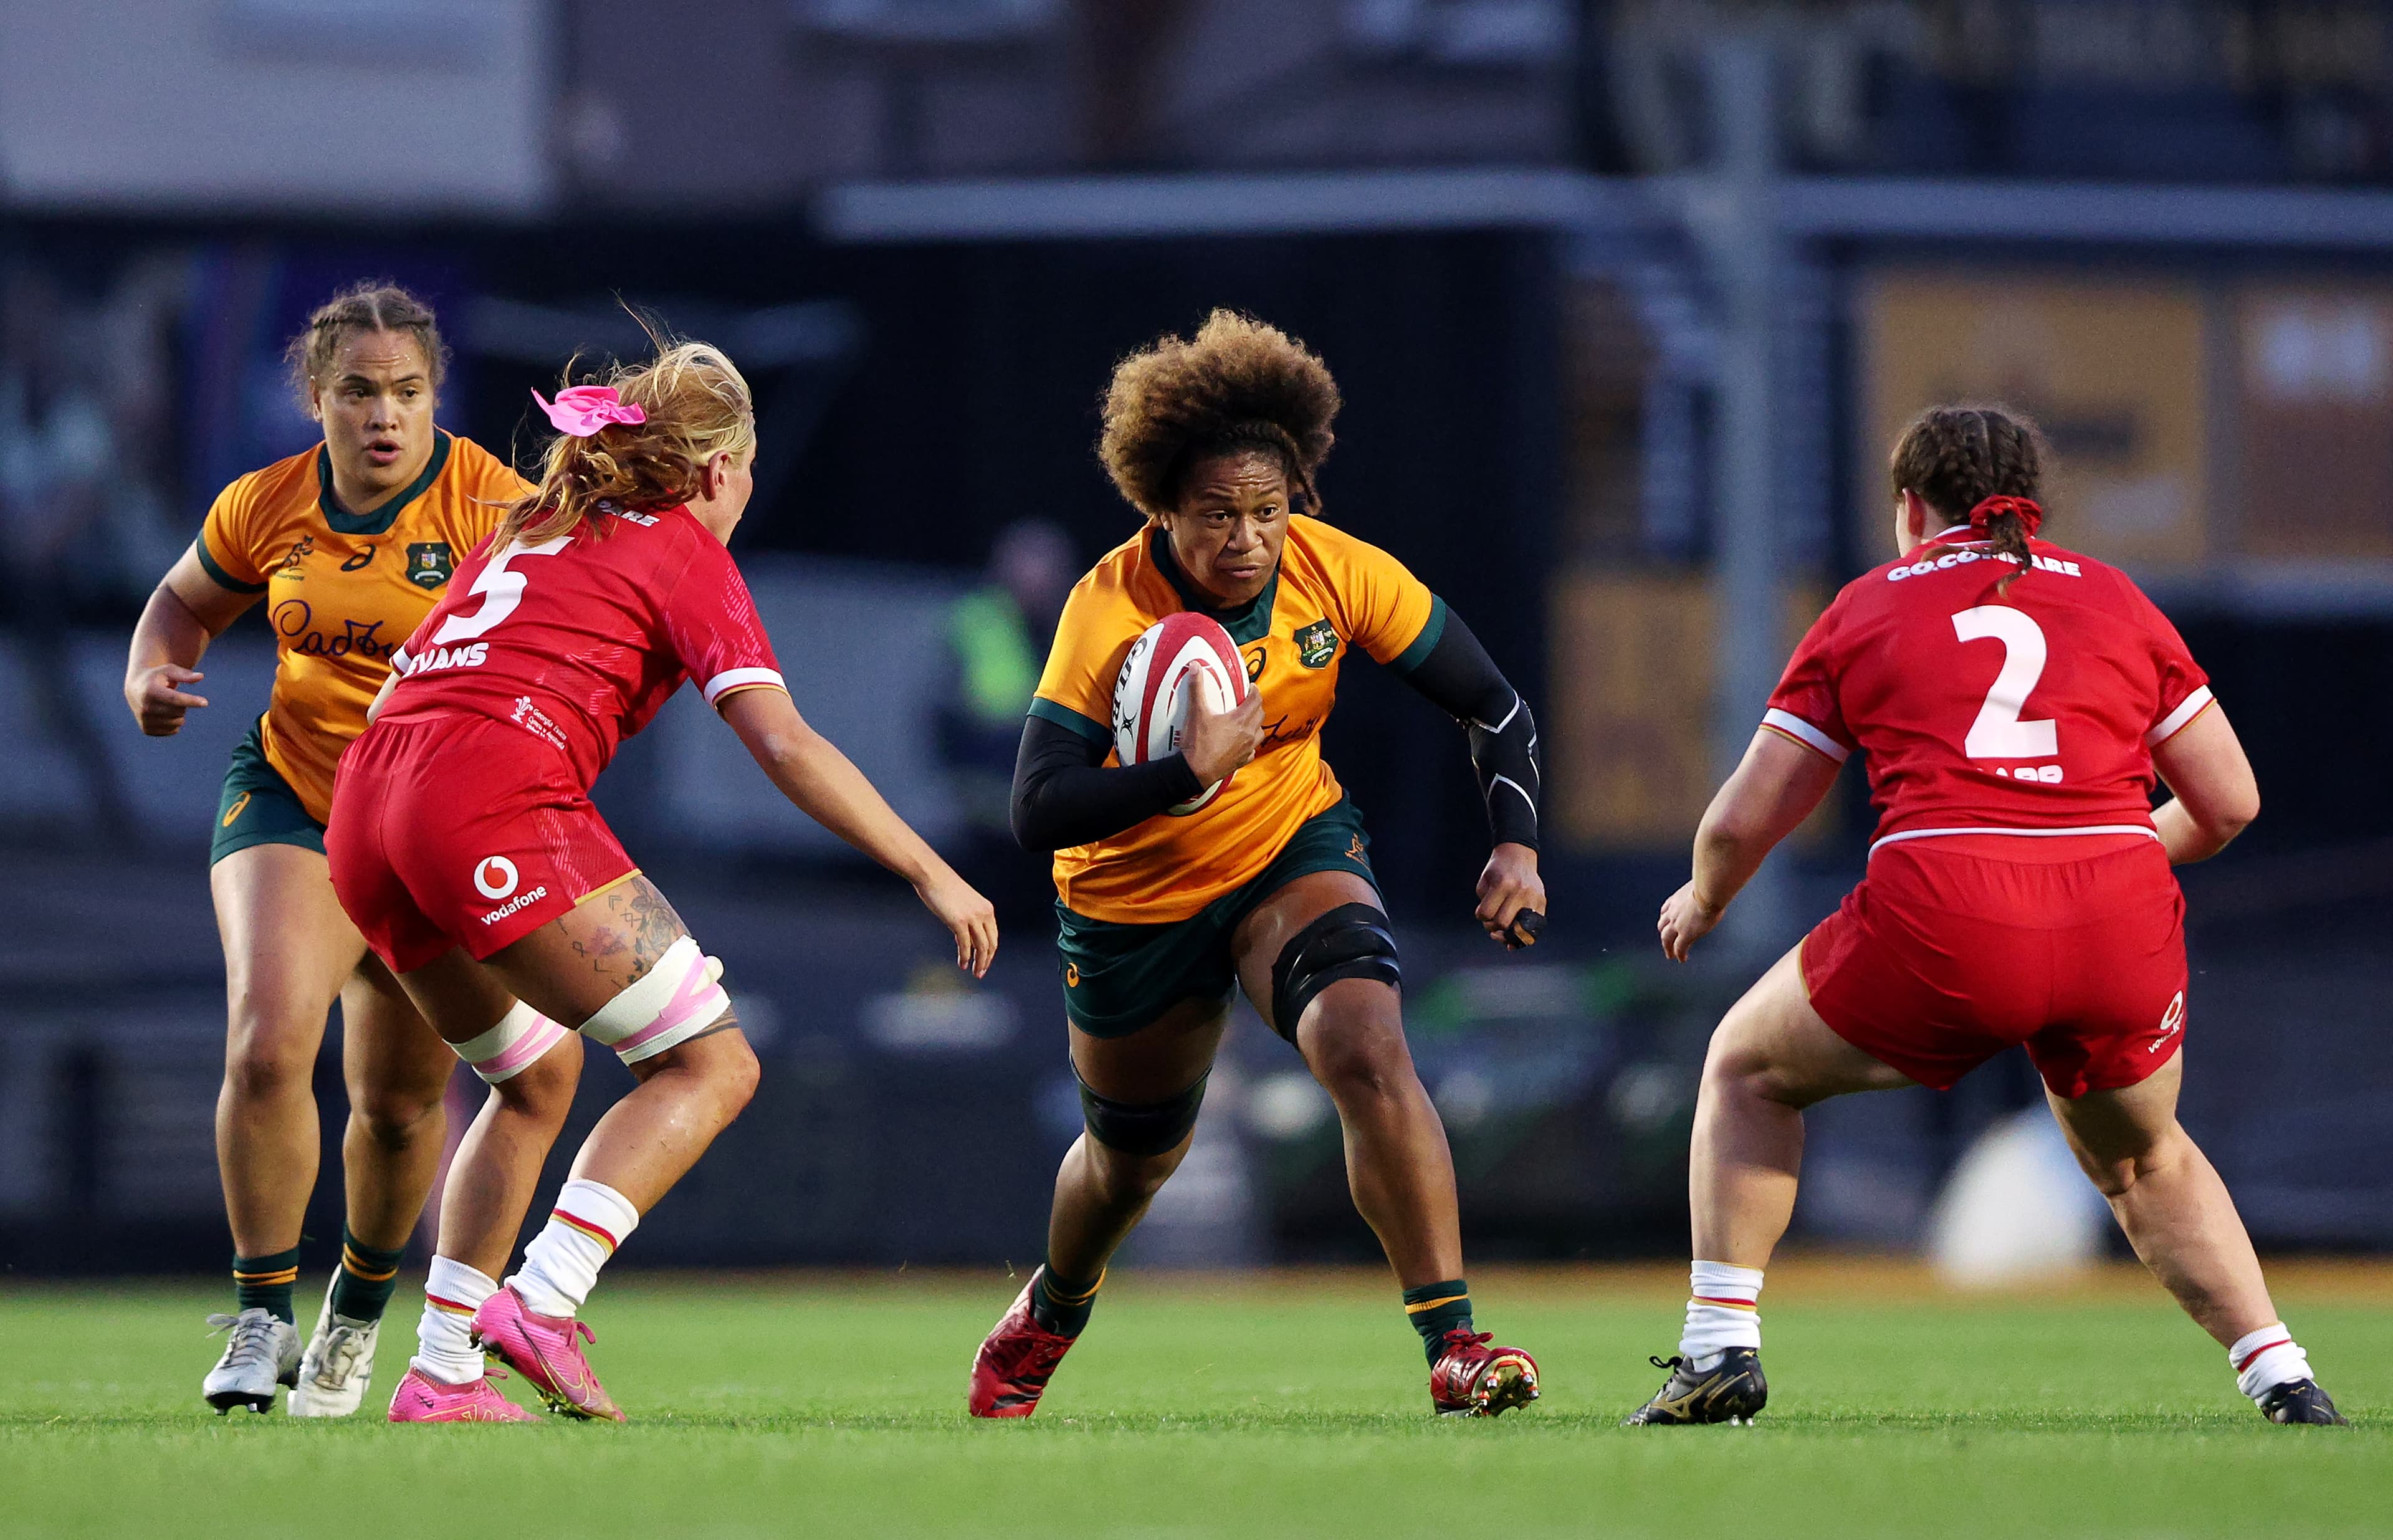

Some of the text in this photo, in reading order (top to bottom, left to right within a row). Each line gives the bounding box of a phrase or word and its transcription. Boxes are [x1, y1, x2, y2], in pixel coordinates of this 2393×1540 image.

[432, 536, 575, 644] 5
[402, 642, 490, 679] EVANS
[1951, 605, 2058, 758] 2
[480, 886, 547, 925] vodafone
